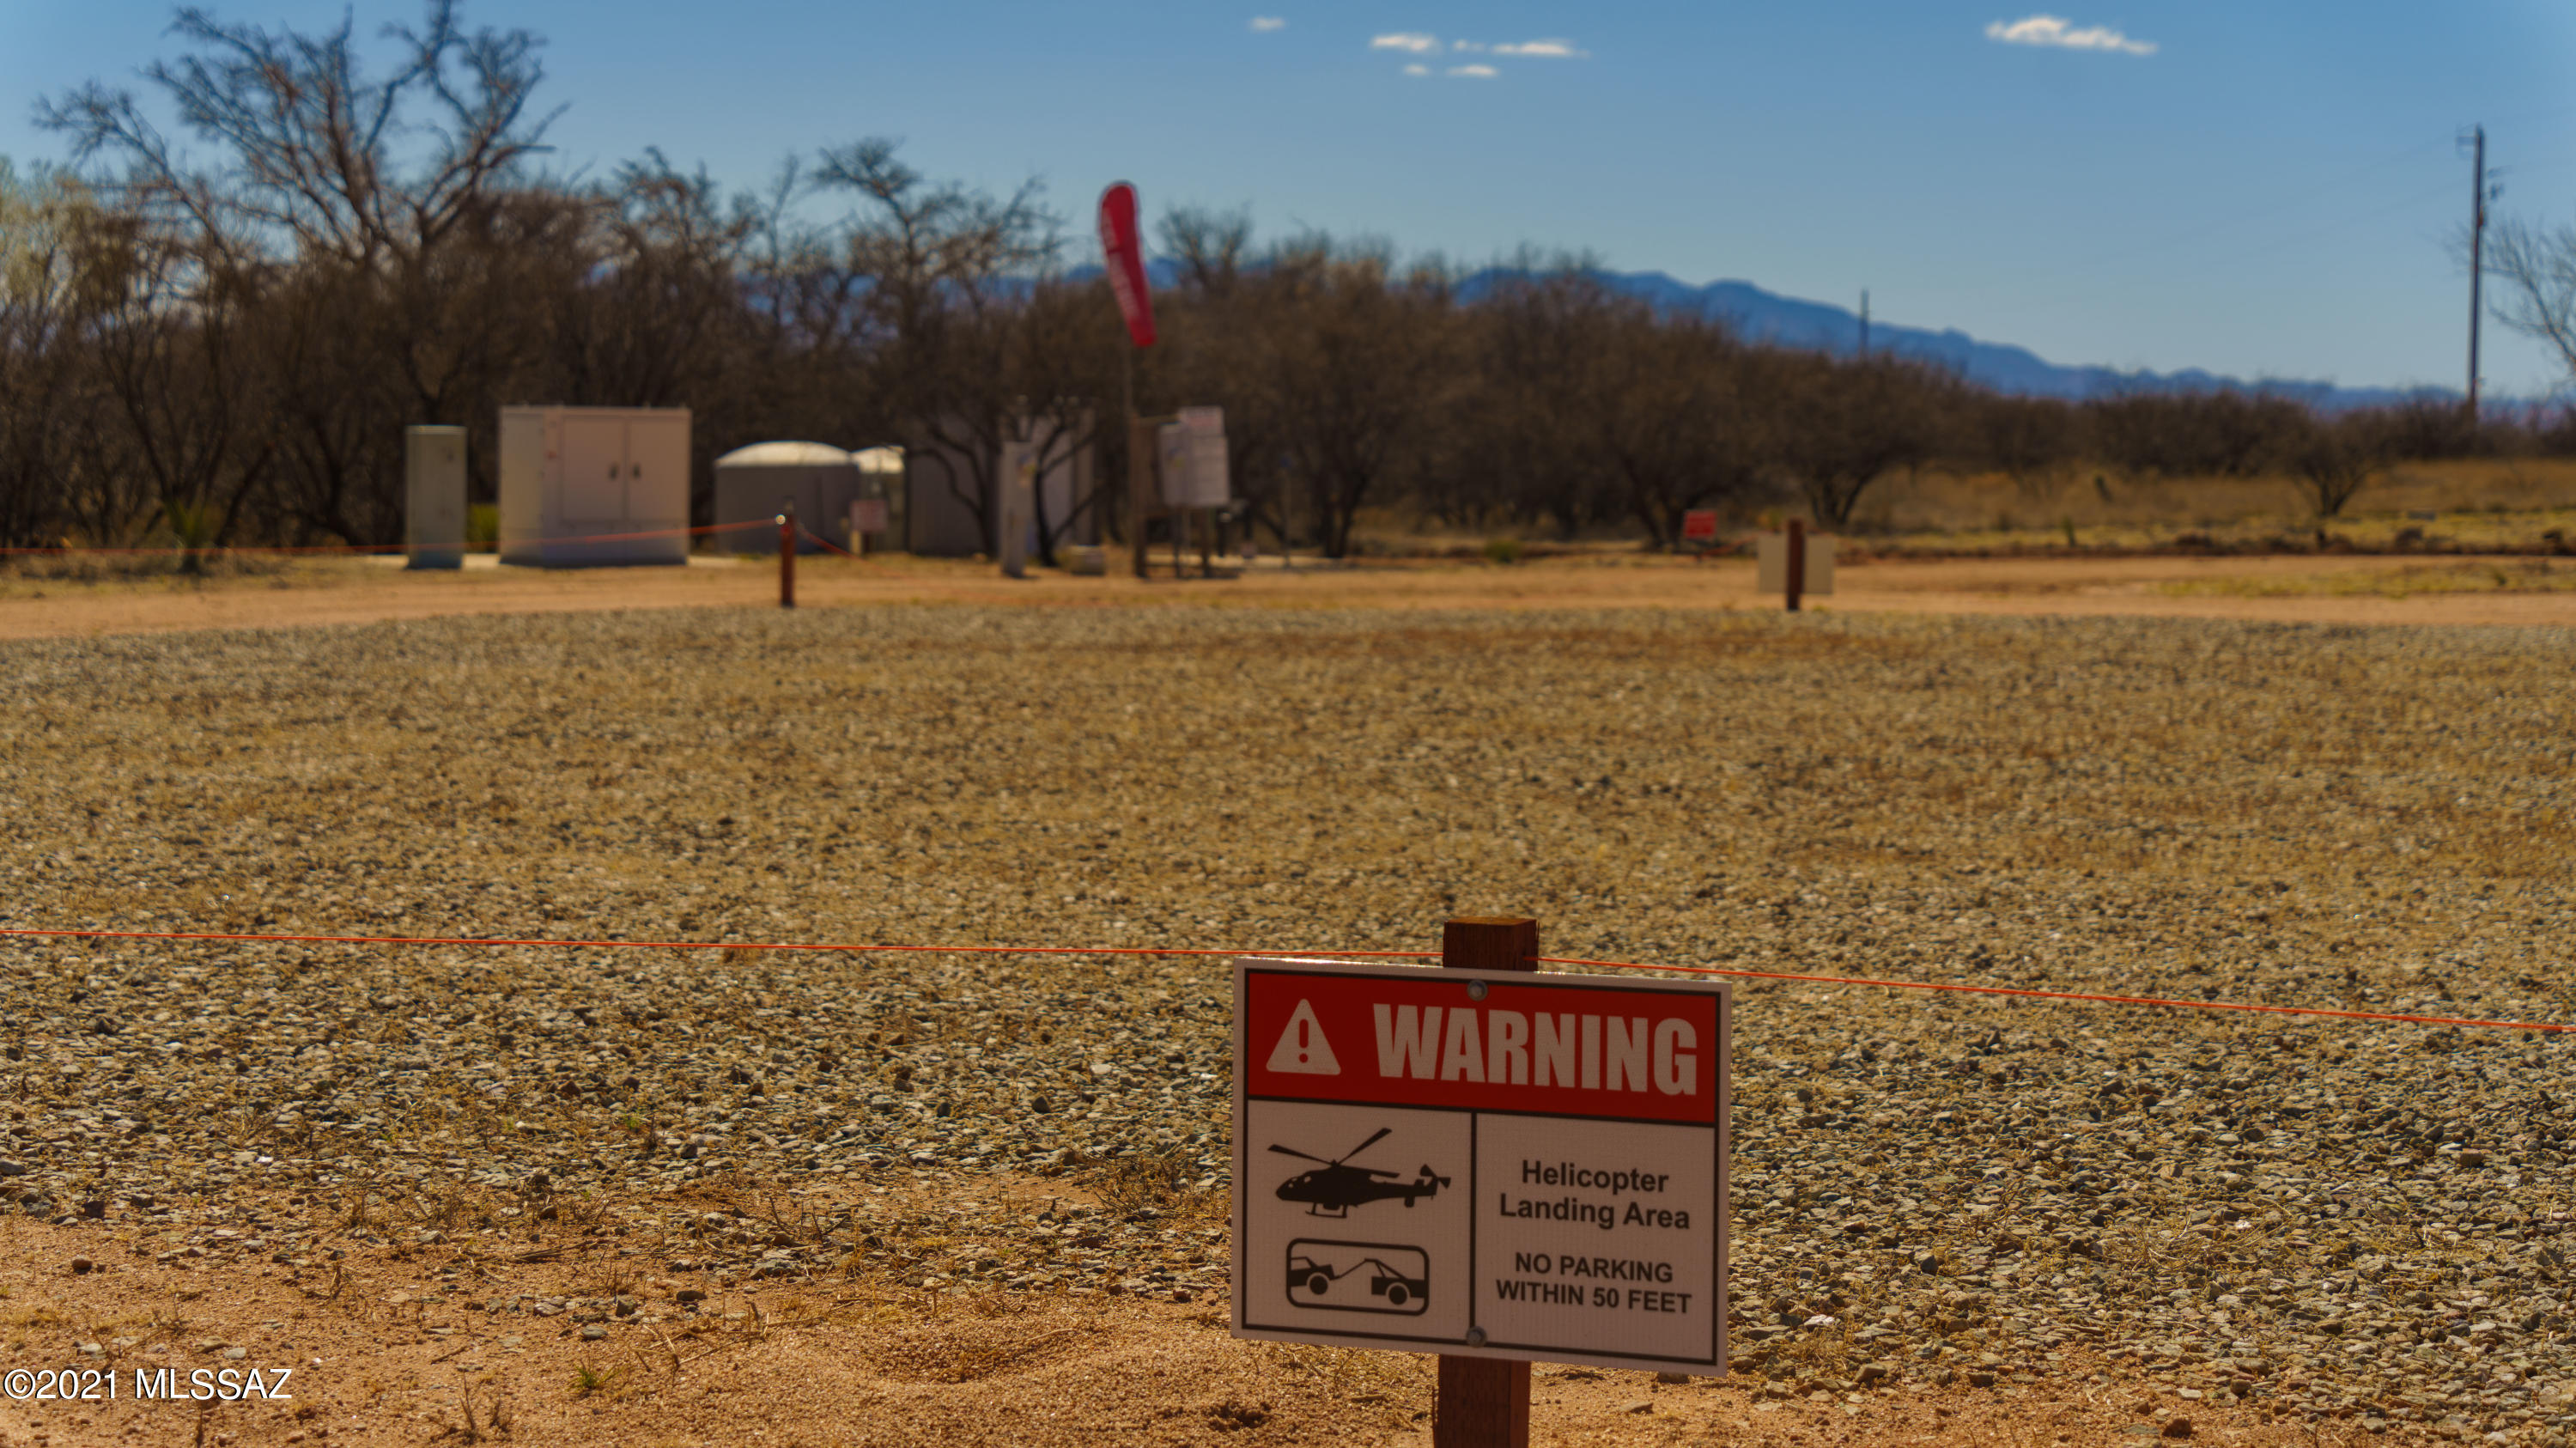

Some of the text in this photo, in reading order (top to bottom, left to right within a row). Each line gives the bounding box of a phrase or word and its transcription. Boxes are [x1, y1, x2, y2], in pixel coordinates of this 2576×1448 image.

[1373, 1003, 1698, 1096] WARNING
[1522, 1159, 1669, 1194] Helicopter
[1499, 1193, 1690, 1230] Landing Area
[1515, 1251, 1674, 1283] NO PARKING
[1496, 1279, 1692, 1314] WITHIN 50 FEET
